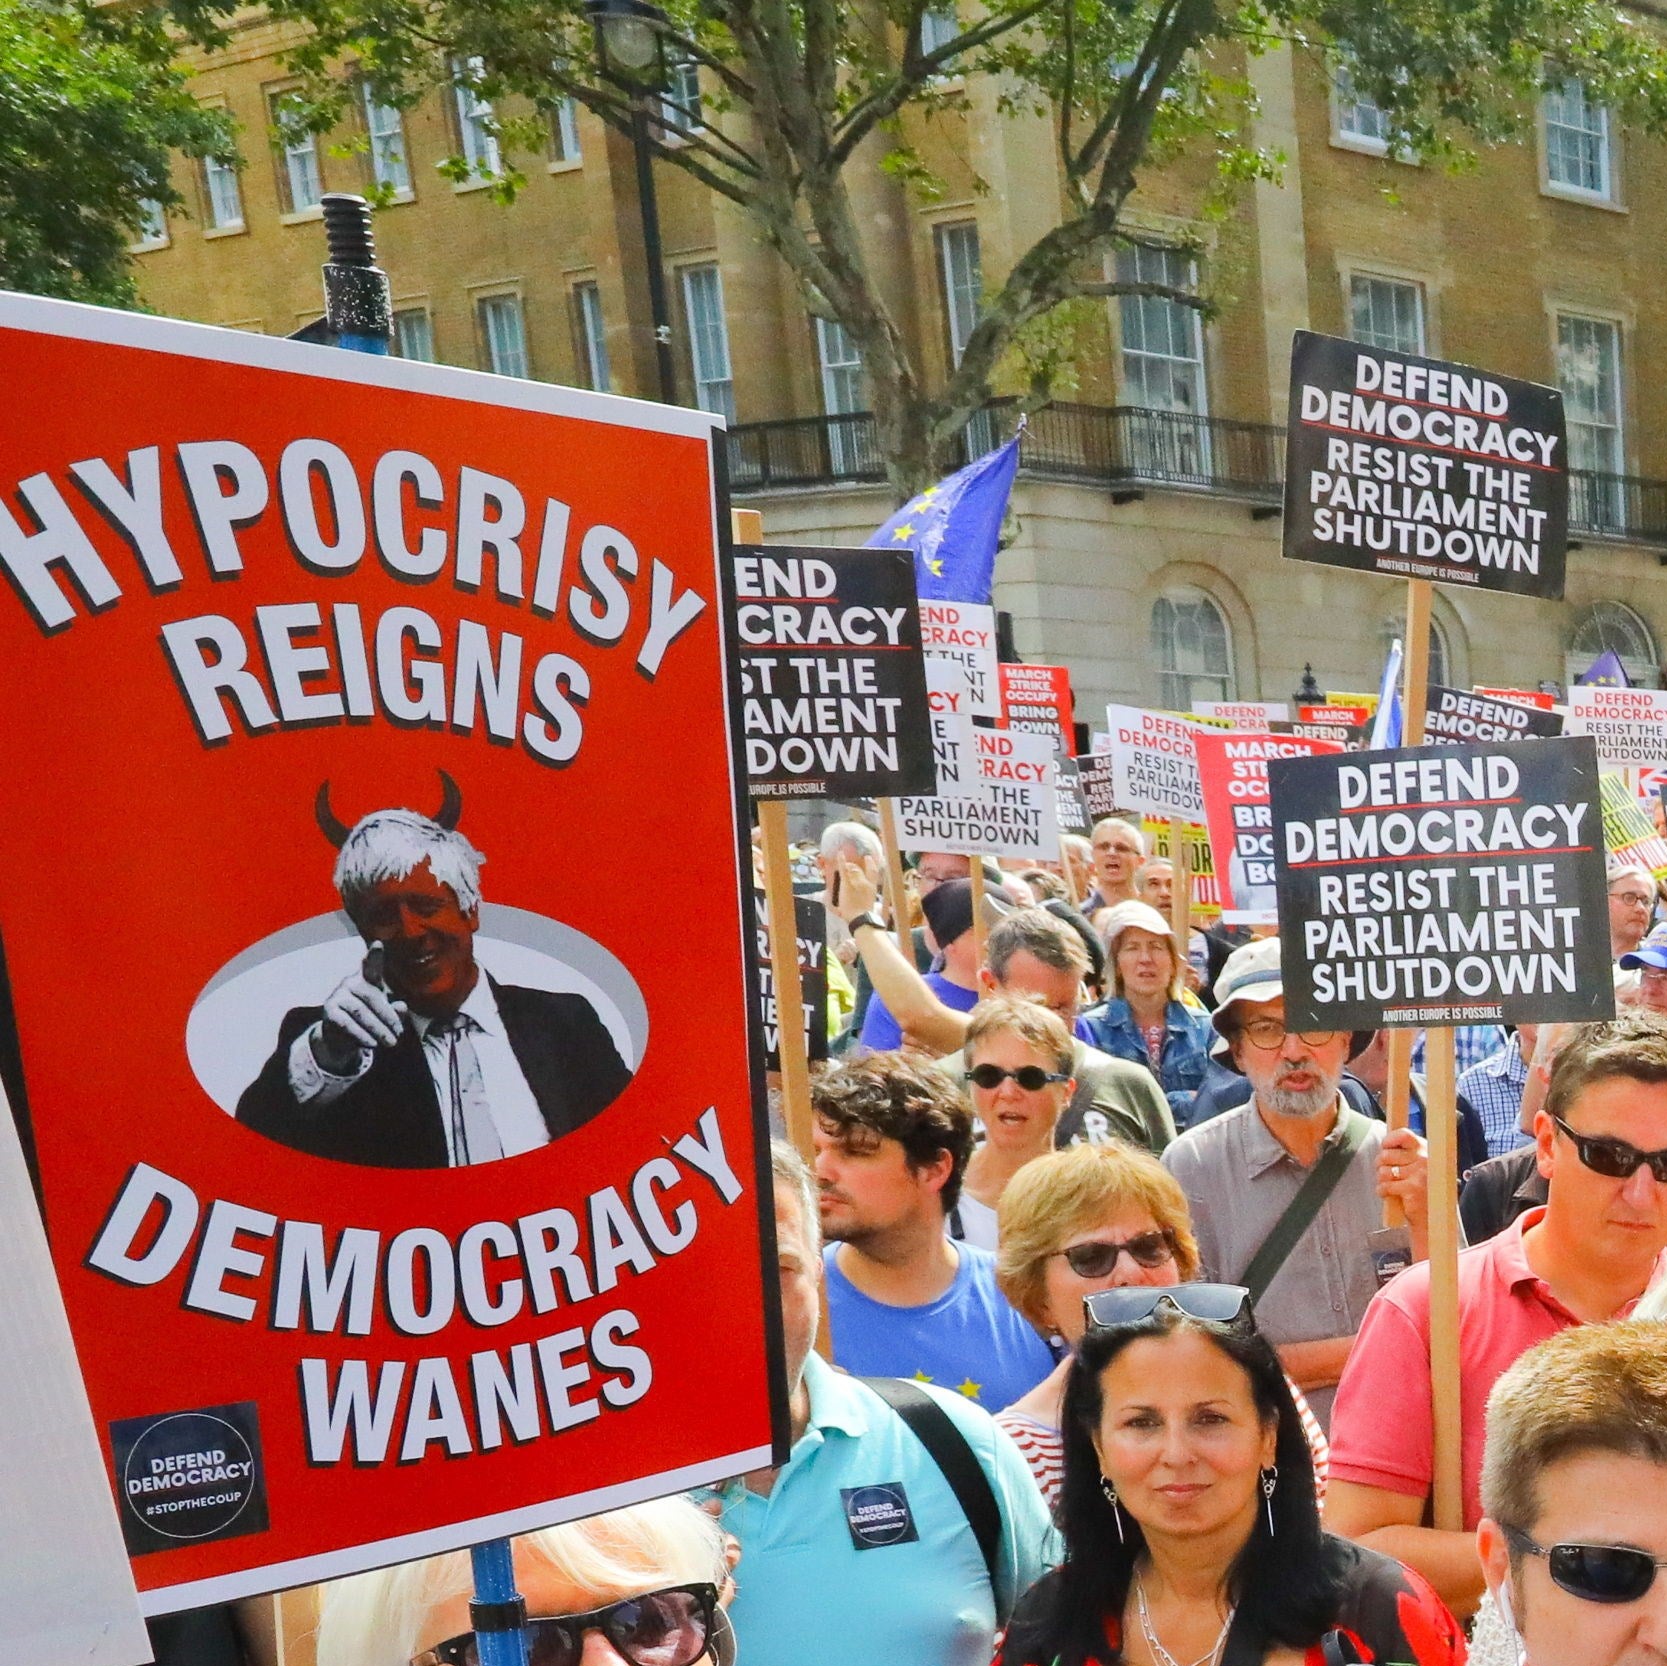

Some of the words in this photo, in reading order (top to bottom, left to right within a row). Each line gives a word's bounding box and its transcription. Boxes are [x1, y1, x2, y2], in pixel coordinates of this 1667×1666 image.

[1357, 355, 1508, 416] DEFEND
[1301, 385, 1559, 467] DEMOCRACY
[1327, 438, 1452, 488] RESIST
[1463, 462, 1531, 505] THE
[1310, 471, 1547, 541] PARLIAMENT
[0, 438, 708, 680] HYPOCRISY
[1313, 508, 1539, 574] SHUTDOWN
[161, 602, 591, 765] REIGNS
[790, 658, 878, 694] THE
[1594, 692, 1653, 706] DEFEND
[1441, 694, 1529, 728] DEFEND
[1338, 756, 1519, 809] DEFEND
[900, 798, 1042, 825] PARLIAMENT
[905, 820, 1039, 846] SHUTDOWN
[1285, 803, 1588, 863] DEMOCRACY
[1319, 868, 1457, 915] RESIST
[1470, 863, 1557, 906] THE
[1305, 908, 1580, 960] PARLIAMENT
[1312, 953, 1576, 1002] SHUTDOWN
[87, 1106, 744, 1336] DEMOCRACY
[300, 1309, 653, 1465] WANES
[128, 1461, 252, 1496] DEMOCRACY
[151, 1449, 226, 1474] DEFEND
[145, 1491, 242, 1517] #STOPTHECOUP
